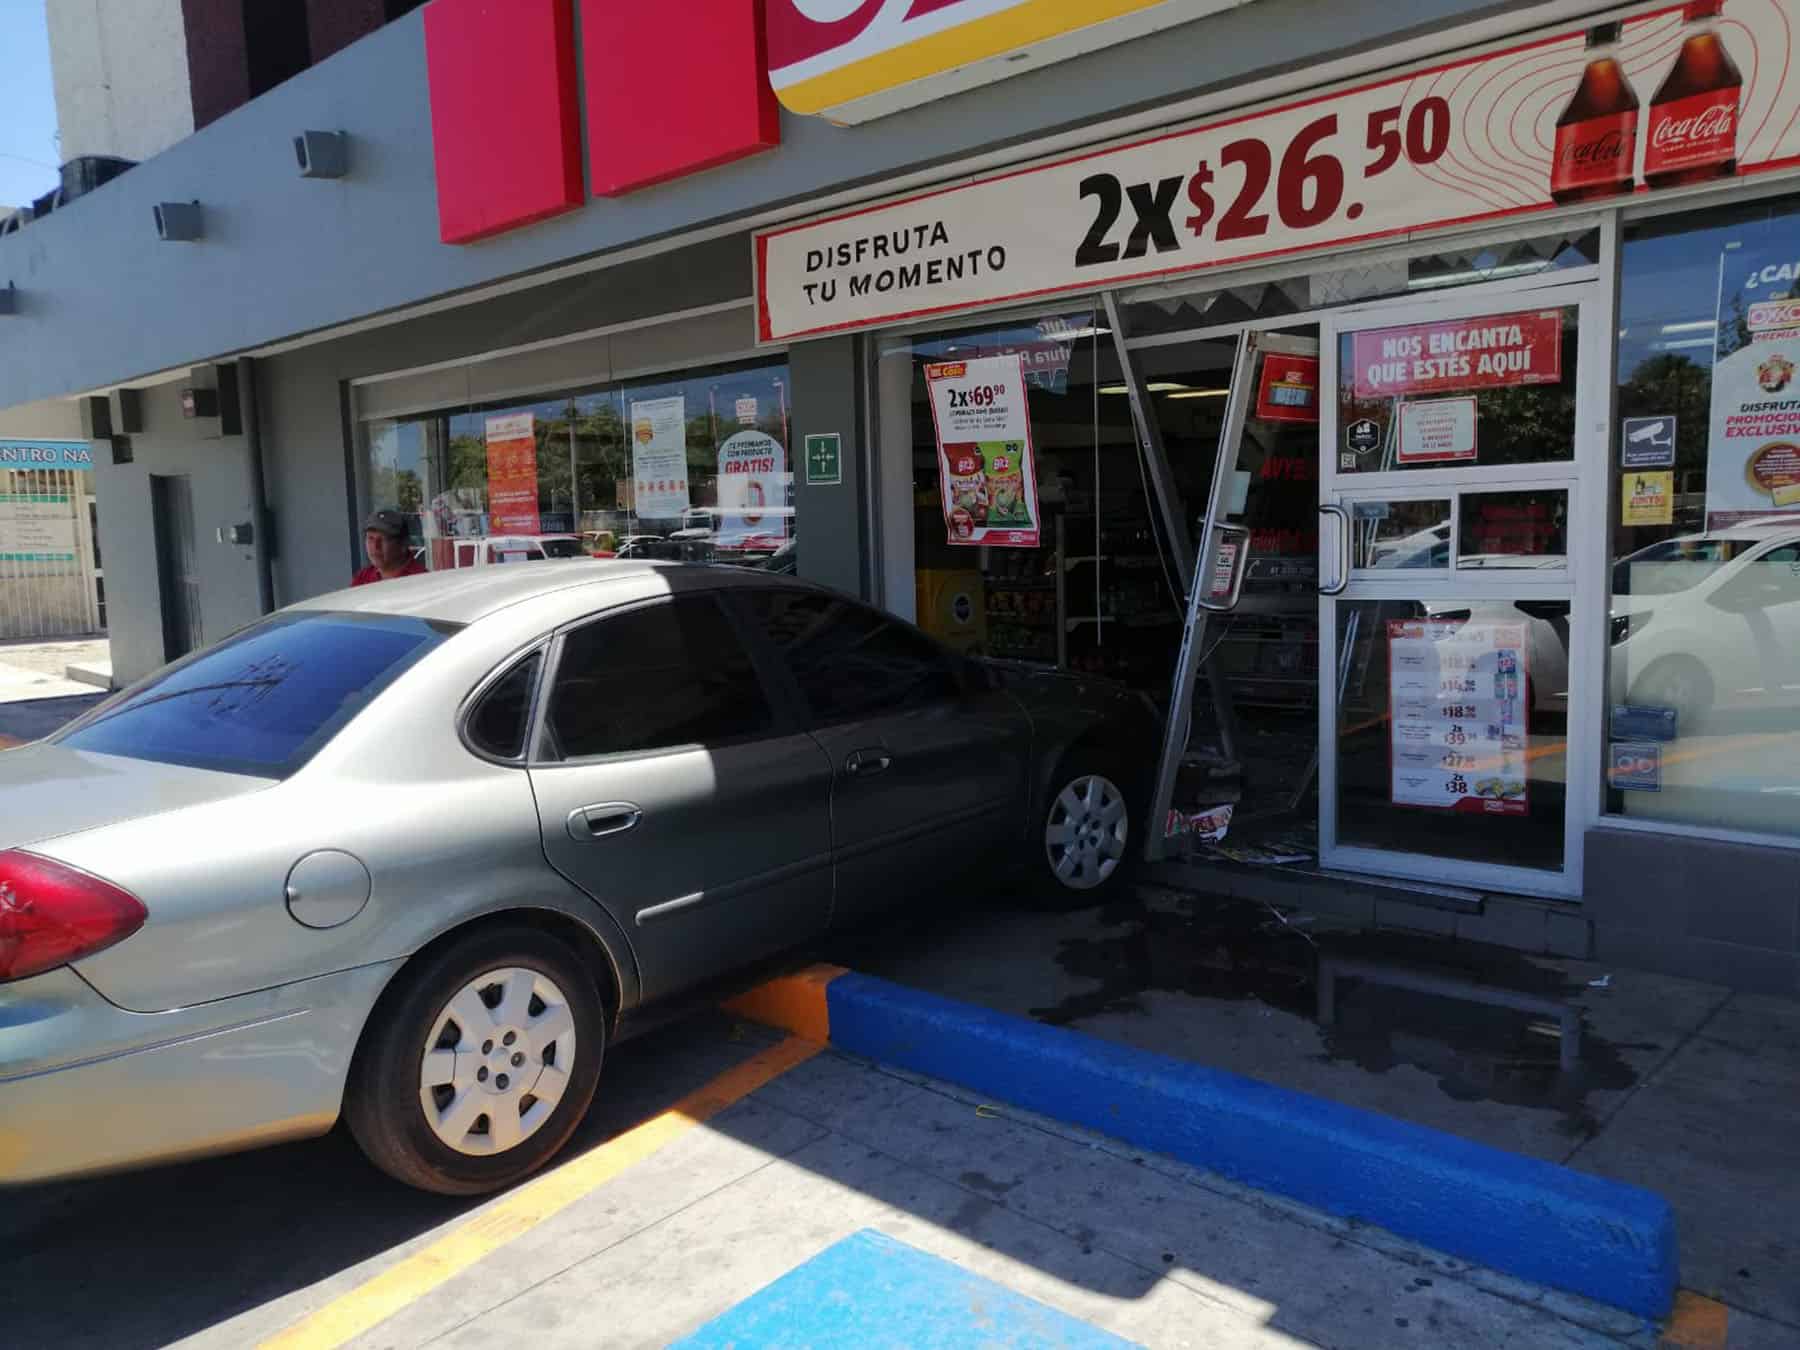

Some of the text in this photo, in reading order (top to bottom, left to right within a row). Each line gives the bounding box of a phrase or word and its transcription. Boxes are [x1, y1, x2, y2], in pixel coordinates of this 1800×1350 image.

[1652, 103, 1736, 148] Coca-Cola
[805, 220, 950, 274] DISFRUTA
[802, 244, 1007, 306] TU MOMENTO
[1383, 325, 1523, 359] NOS ENCANTA
[1367, 344, 1534, 389] QUE ESTÉS AQUÍ
[725, 457, 775, 473] GRATIS!
